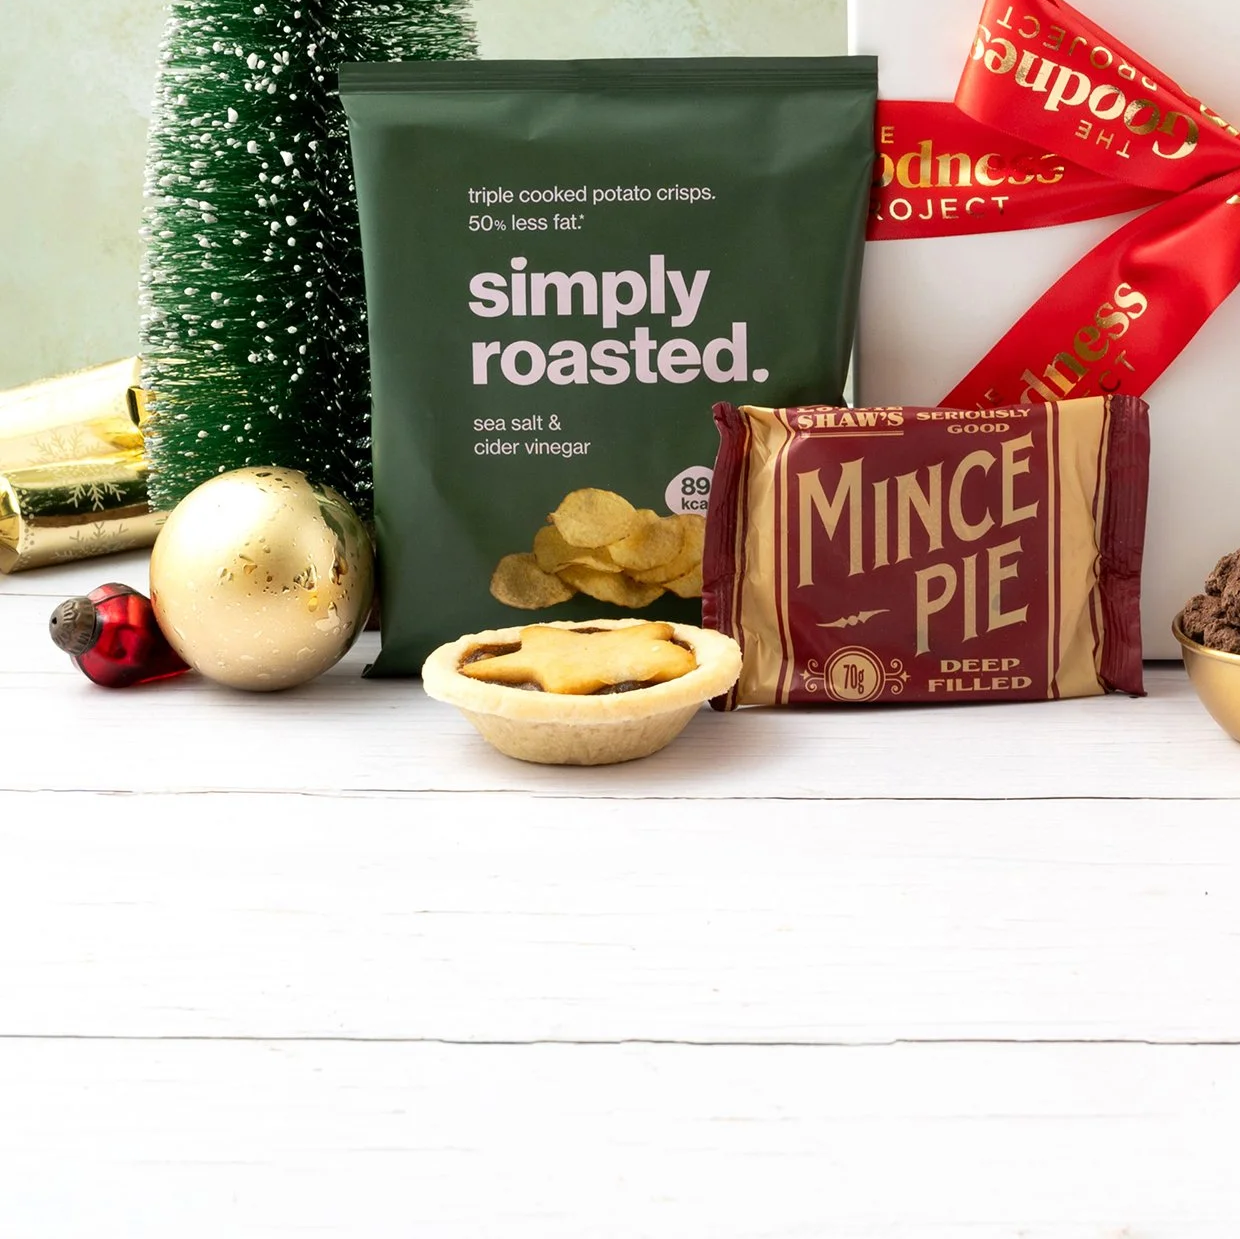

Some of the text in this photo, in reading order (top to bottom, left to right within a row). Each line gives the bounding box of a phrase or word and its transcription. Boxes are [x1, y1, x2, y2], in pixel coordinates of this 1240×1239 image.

[969, 23, 1199, 159] Goodnes
[1075, 119, 1131, 159] THE
[468, 184, 716, 208] triple cooked potato crisps.
[877, 197, 1009, 221] OJECT
[468, 215, 506, 231] 50%
[511, 214, 548, 231] less
[468, 254, 711, 328] simply
[472, 322, 769, 386] roasted.
[474, 415, 561, 432] sea salt &
[797, 411, 905, 429] SHAW'S
[916, 408, 1031, 421] SERIOUSLY
[947, 423, 1010, 434] GOOD
[474, 439, 591, 458] cider vinegar
[681, 476, 711, 495] 89
[681, 497, 708, 510] kca
[797, 432, 1039, 589] MINCE
[915, 536, 1030, 657] PIE
[940, 658, 1020, 672] DEEP
[842, 665, 865, 694] 70g
[928, 675, 1032, 692] FILLED
